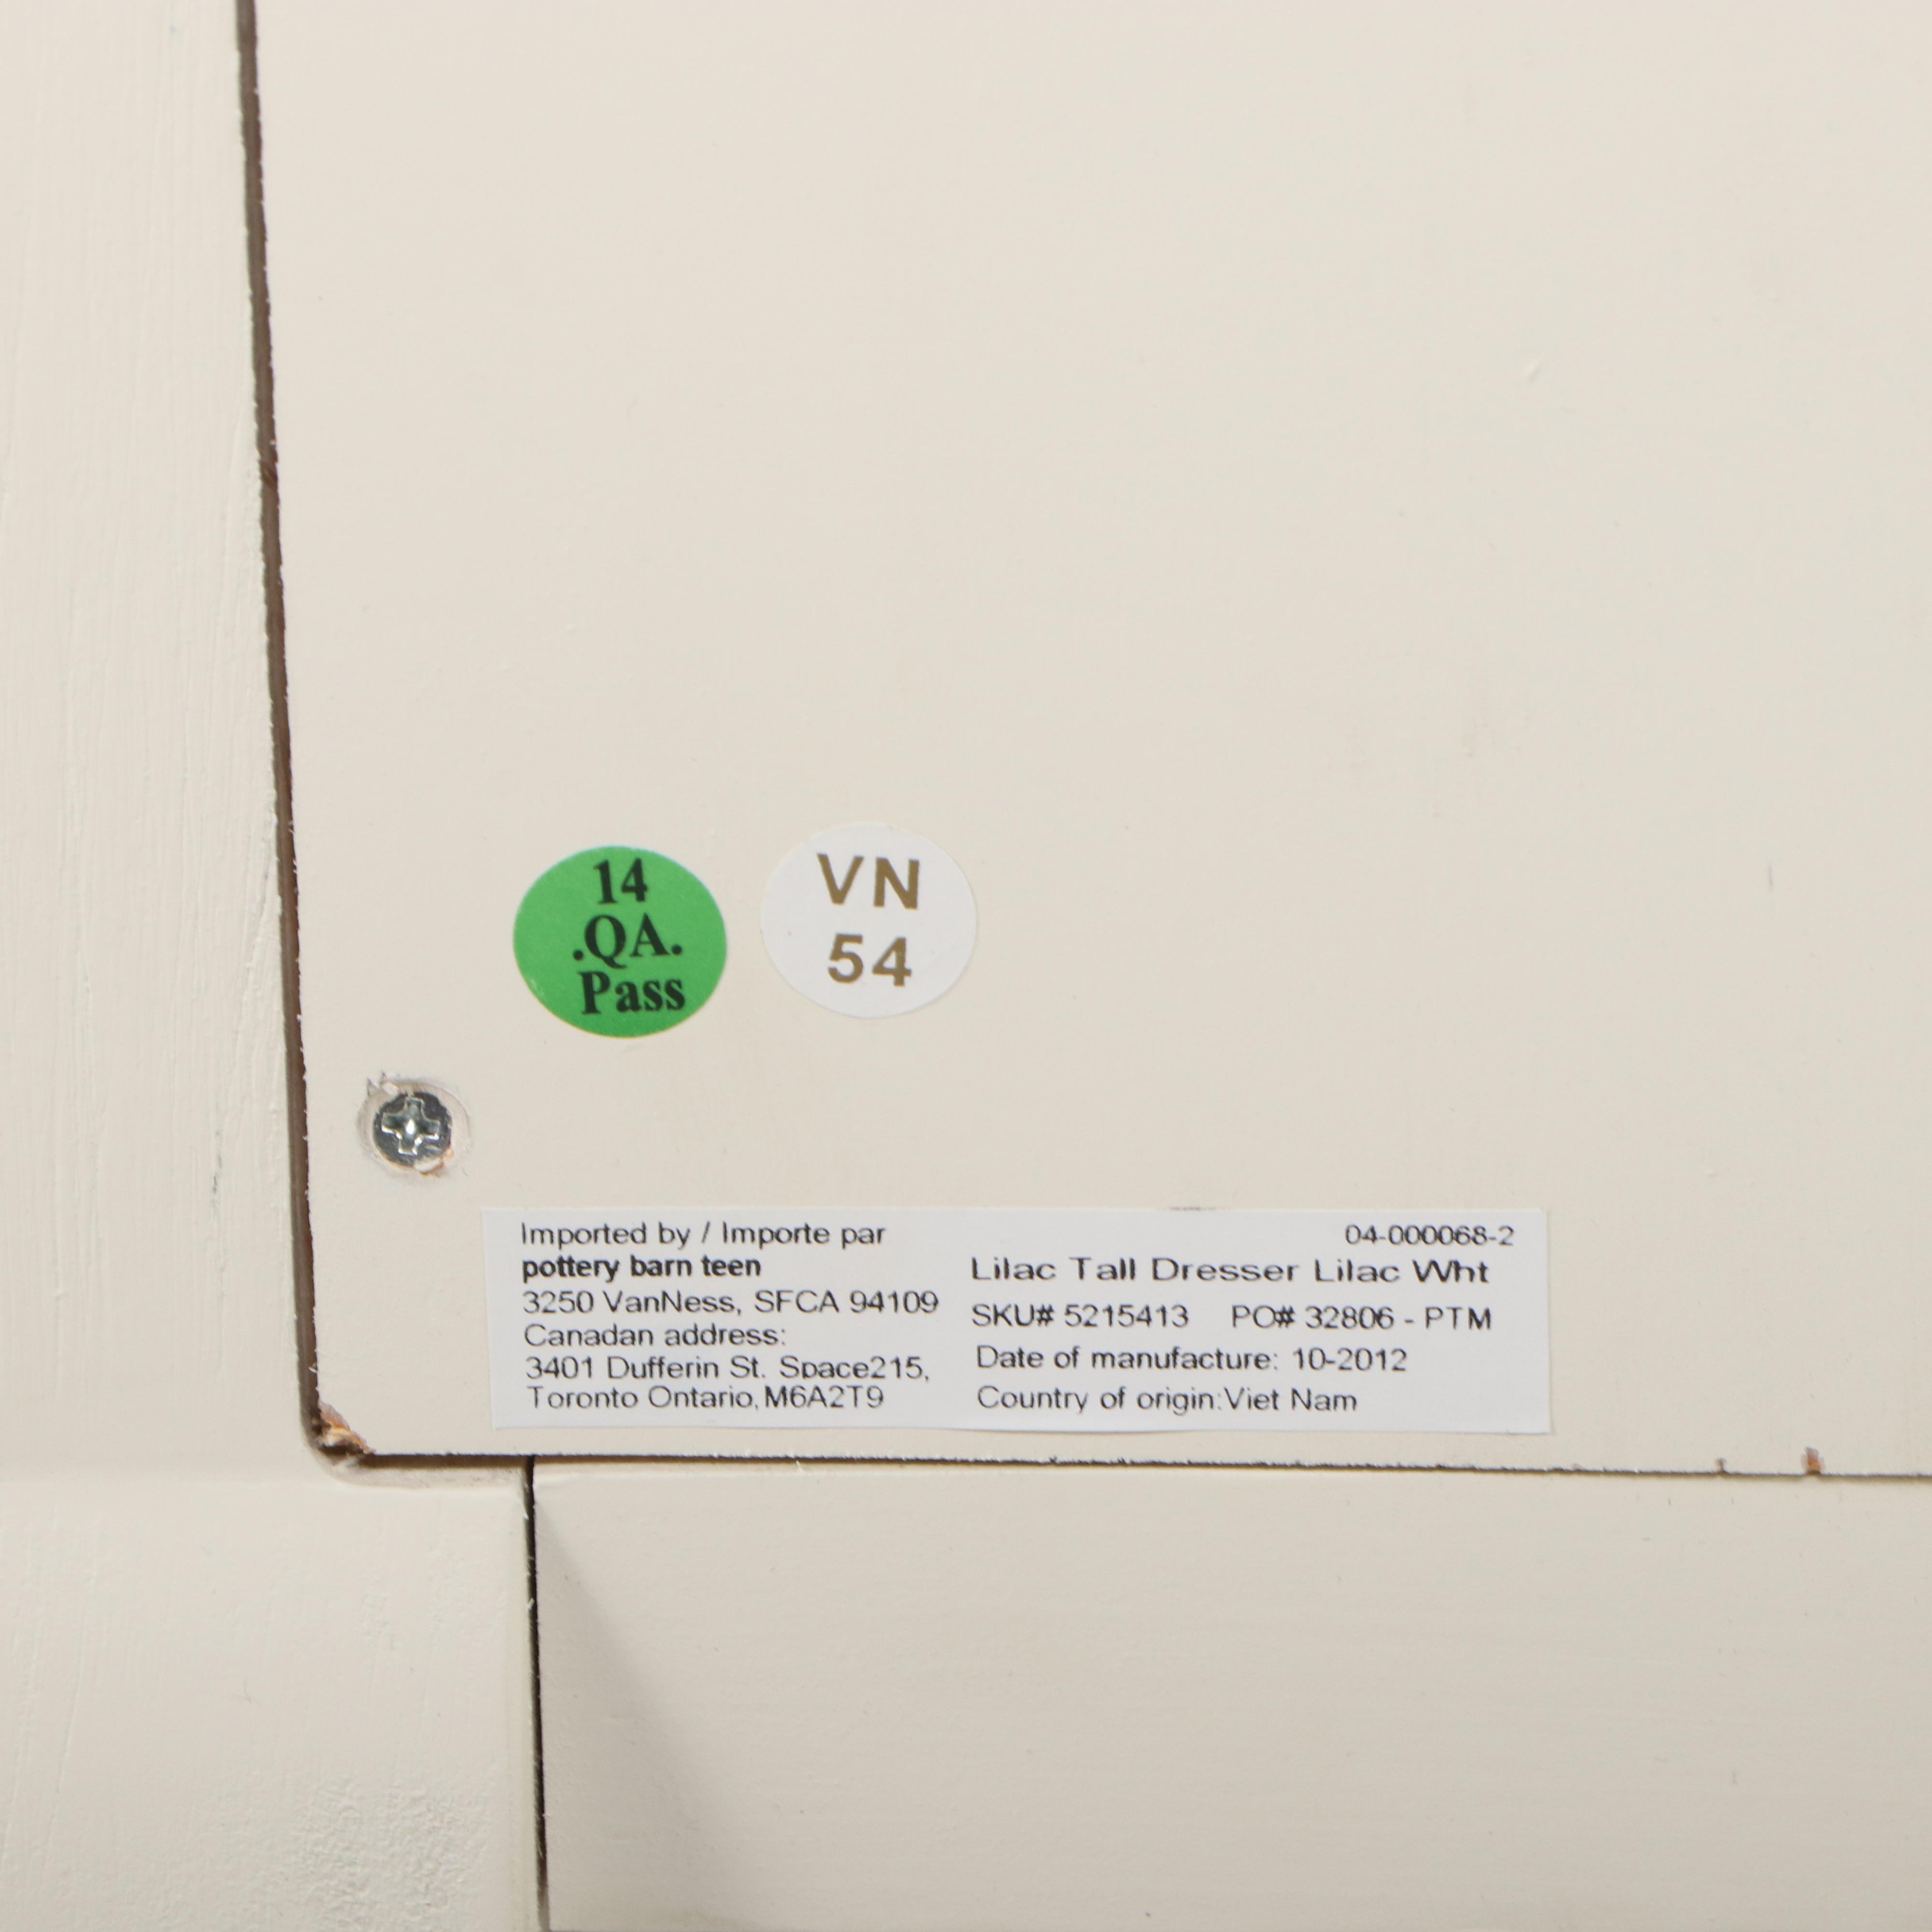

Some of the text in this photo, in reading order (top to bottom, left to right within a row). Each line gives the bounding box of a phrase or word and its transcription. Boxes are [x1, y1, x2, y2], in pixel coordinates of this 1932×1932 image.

[593, 857, 649, 905] 14
[816, 852, 921, 910] VN
[827, 932, 913, 987] 54
[577, 970, 687, 1016] Pass
[521, 1221, 886, 1251] Imported by / Importe par
[1345, 1224, 1515, 1246] 04-000068-2
[522, 1254, 762, 1284] pottery barn teen
[971, 1257, 1489, 1283] Lilac Tall Dresser Lilac Wht
[523, 1290, 939, 1316] 3250 VanNess, SFCA 94109
[972, 1304, 1189, 1328] SKU# 5215413
[1232, 1305, 1295, 1329] PO#
[1305, 1306, 1395, 1330] 32806
[1425, 1306, 1492, 1330] PTM
[524, 1322, 785, 1347] Canadan address:
[526, 1356, 593, 1379] 3401
[607, 1356, 719, 1379] Dufferin
[729, 1355, 766, 1378] St.
[976, 1345, 1407, 1372] Date of manufacture: 10-2012
[527, 1386, 639, 1409] Toronto
[977, 1385, 1088, 1413] Country
[1100, 1386, 1126, 1410] of
[1291, 1388, 1358, 1411] Nam
